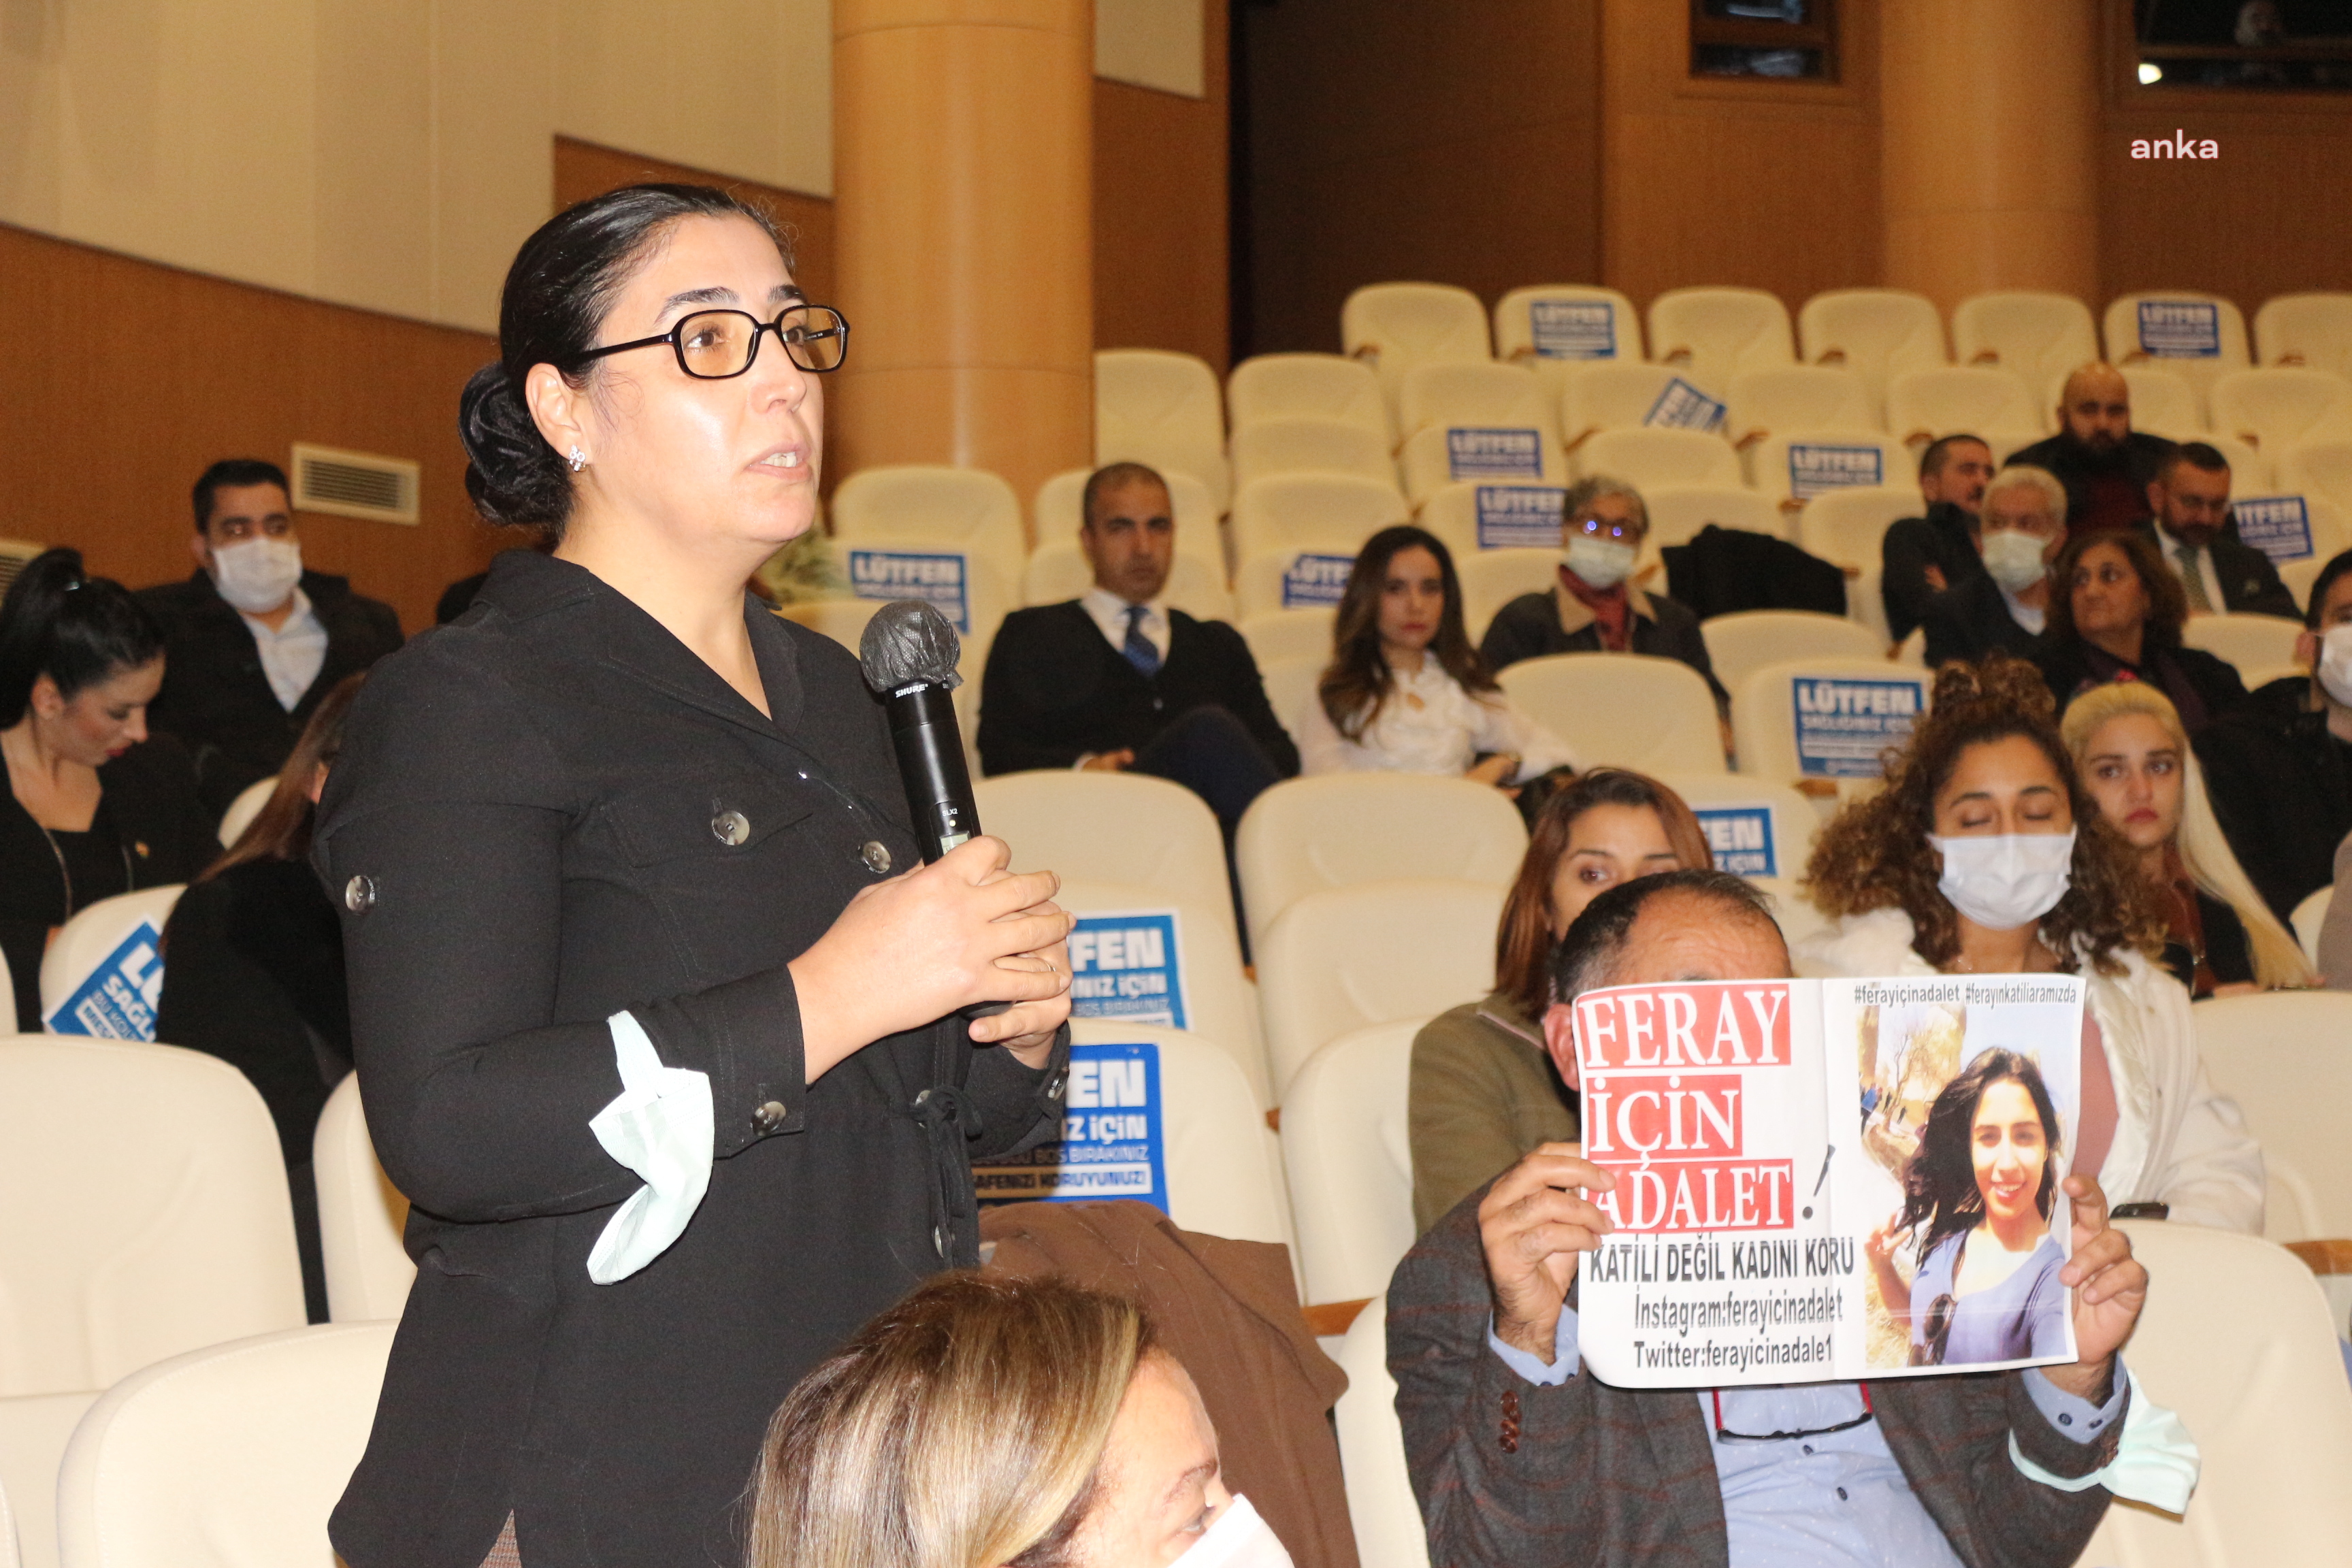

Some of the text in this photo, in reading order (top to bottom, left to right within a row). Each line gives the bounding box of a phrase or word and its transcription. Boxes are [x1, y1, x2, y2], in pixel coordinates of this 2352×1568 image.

[1798, 683, 1916, 715] LÜTFEN
[942, 808, 958, 817] SLX2
[1578, 990, 1788, 1068] FERAY
[1089, 1114, 1148, 1145] İÇİN
[1588, 1075, 1740, 1171] İÇİN
[1590, 1232, 1854, 1283] KATİLİ DEĞİL KADINI KORU
